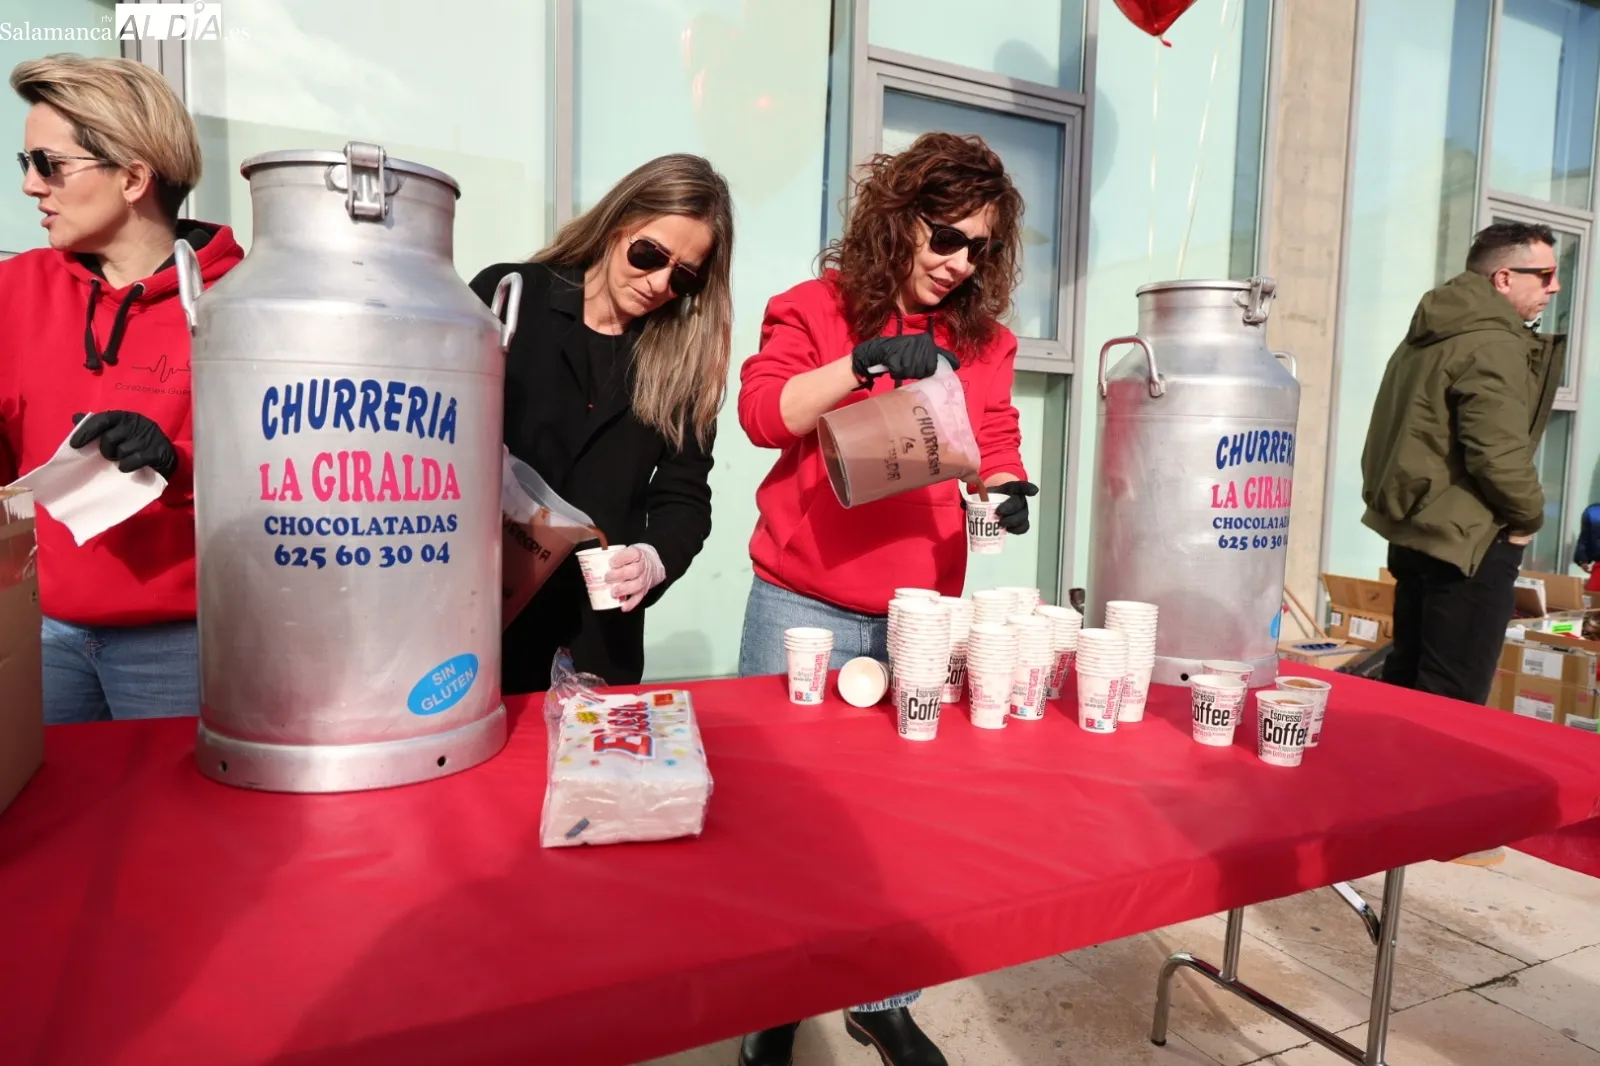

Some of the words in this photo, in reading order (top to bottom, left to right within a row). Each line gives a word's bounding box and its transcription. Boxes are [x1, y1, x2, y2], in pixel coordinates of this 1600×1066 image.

[262, 378, 457, 444] CHURRERIA
[259, 458, 303, 502] LA
[312, 450, 461, 502] GIRALDA
[1211, 481, 1238, 509] LA
[264, 514, 458, 536] CHOCOLATADAS
[968, 517, 1000, 537] offee
[1218, 534, 1248, 550] 625
[1252, 534, 1268, 549] 60
[1270, 534, 1282, 549] 30
[274, 544, 327, 569] 625
[335, 544, 371, 566] 60
[379, 544, 413, 568] 30
[421, 542, 450, 565] 04
[432, 663, 456, 686] SIN
[421, 668, 474, 711] GLUTEN
[1193, 701, 1231, 727] offee
